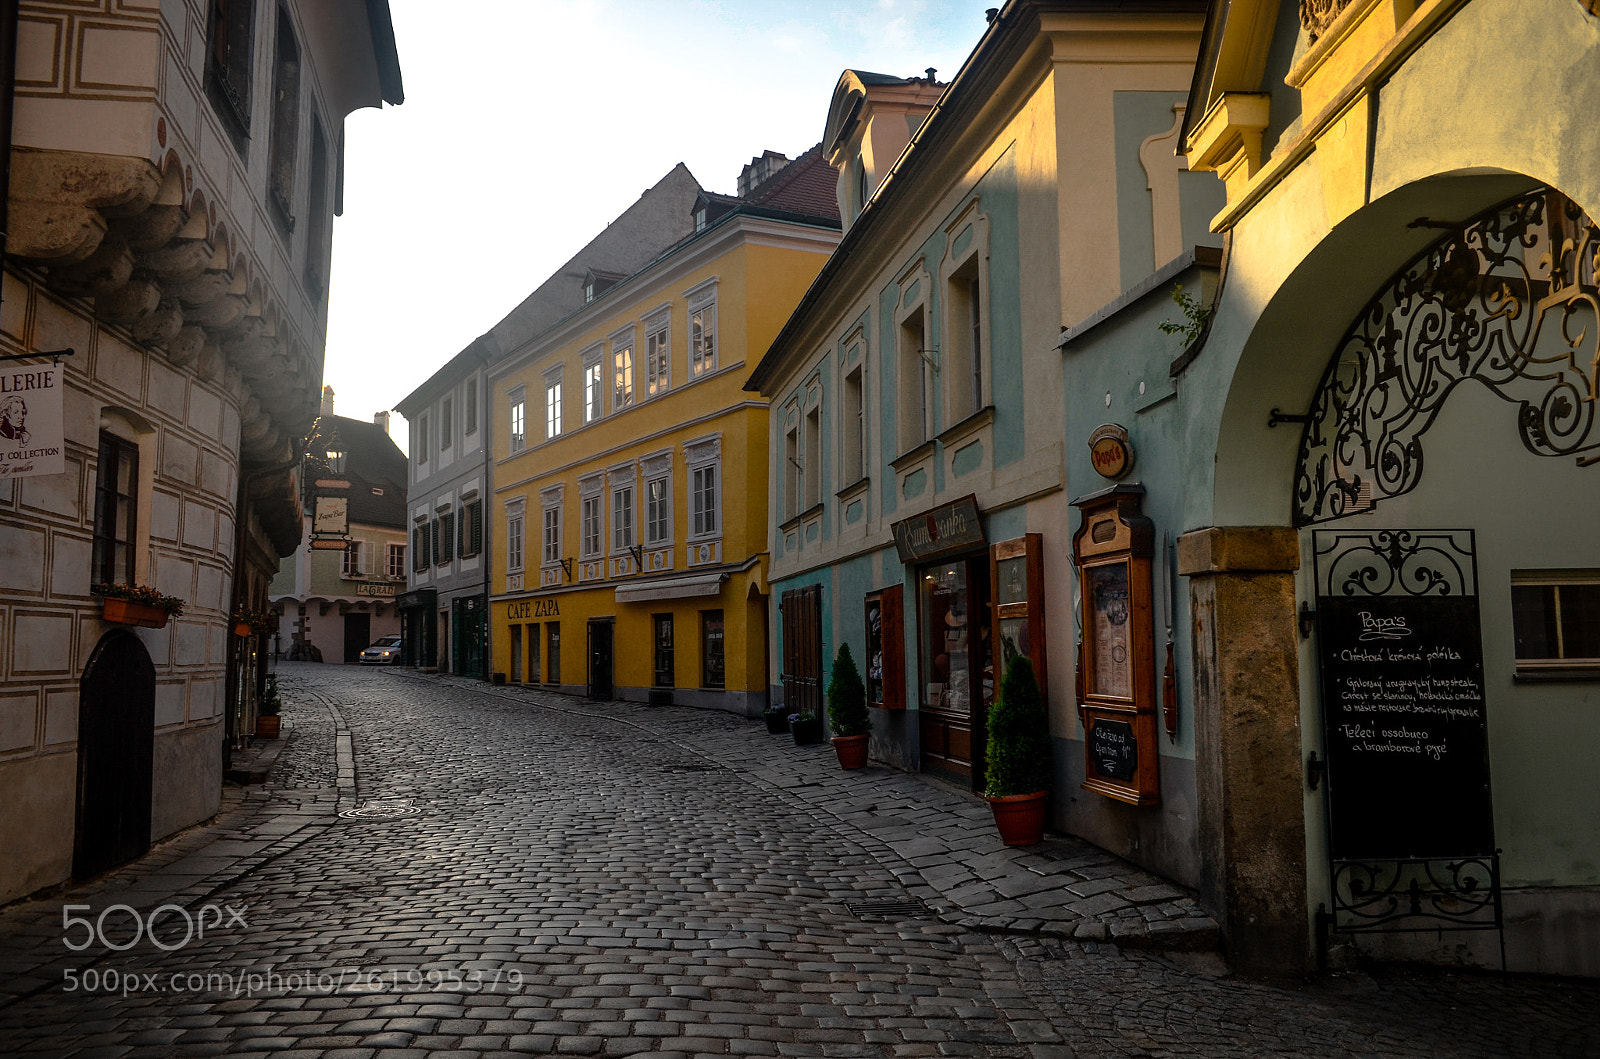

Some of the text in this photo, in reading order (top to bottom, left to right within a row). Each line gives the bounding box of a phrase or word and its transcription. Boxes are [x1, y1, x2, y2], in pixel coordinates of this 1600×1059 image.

[8, 448, 59, 460] COLLECTION
[507, 599, 560, 620] CAFE ZAPA
[1357, 611, 1406, 633] Papa's
[1341, 720, 1429, 739] Telecí ossobuco
[1363, 740, 1421, 753] bramborové
[1424, 737, 1447, 760] pyré
